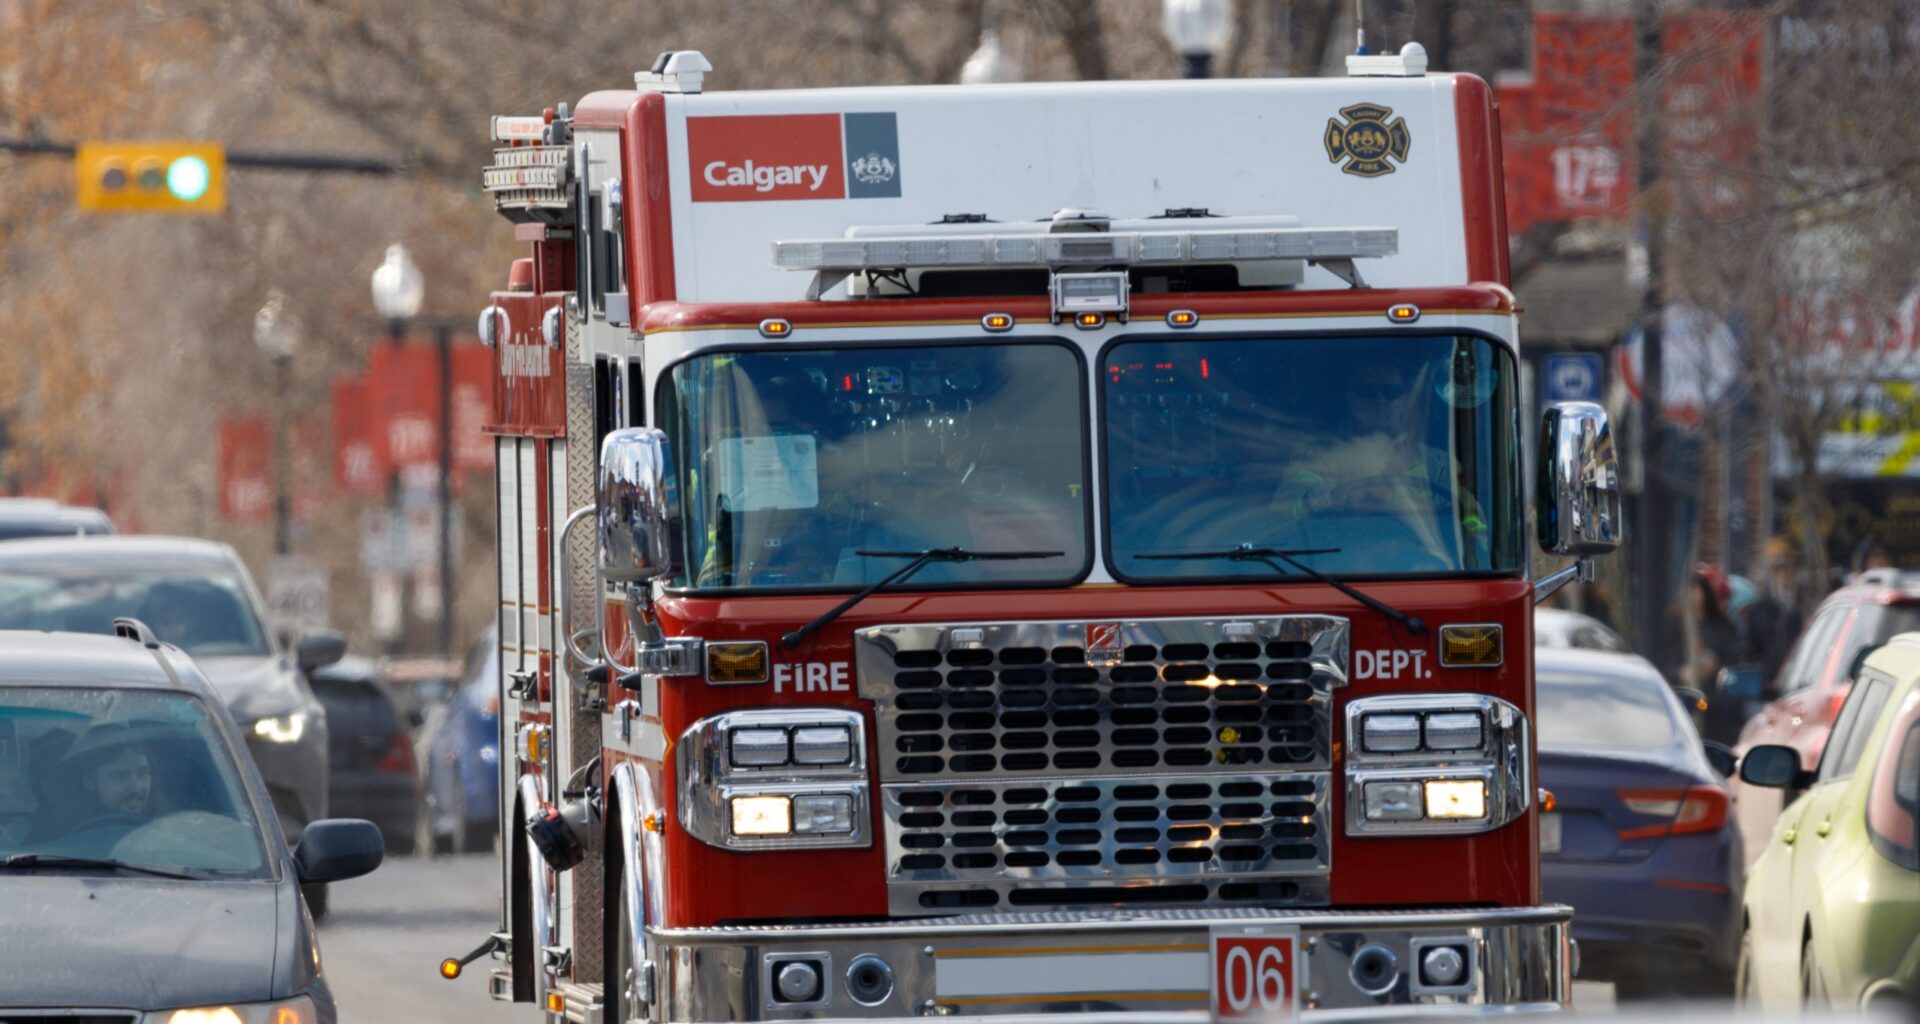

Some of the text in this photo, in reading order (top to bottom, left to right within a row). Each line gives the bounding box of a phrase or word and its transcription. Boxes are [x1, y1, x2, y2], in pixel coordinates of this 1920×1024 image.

[703, 160, 828, 192] Calgary
[773, 661, 850, 693] FIRE
[1355, 649, 1433, 679] DEPT.
[1225, 945, 1285, 1012] 06
